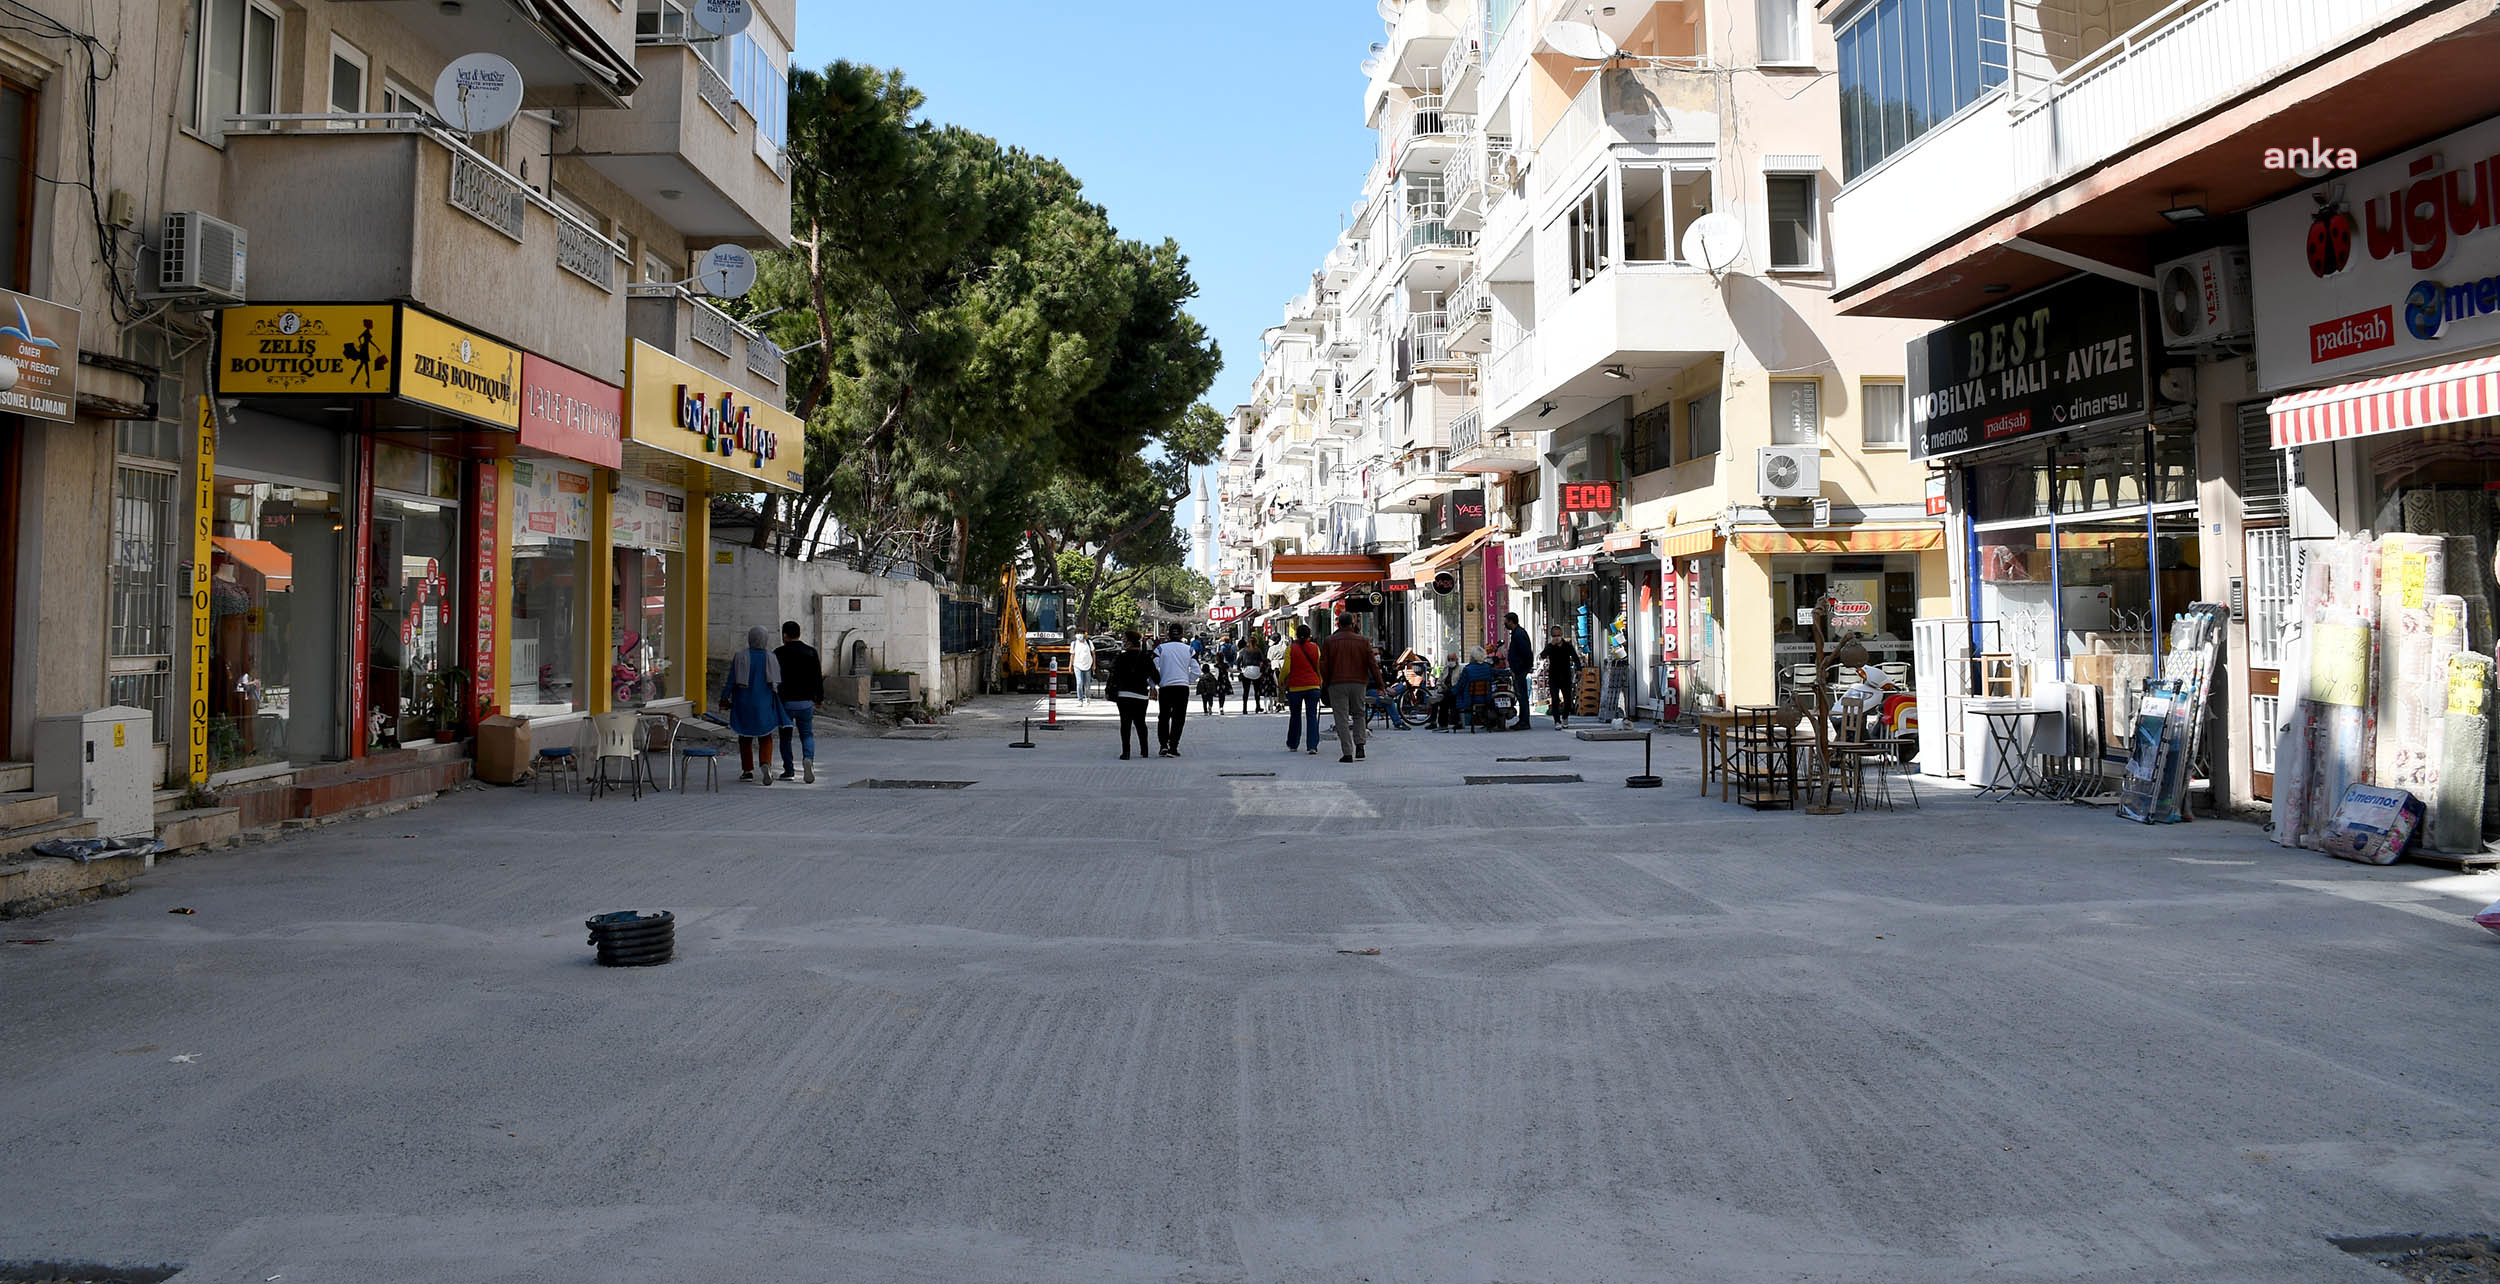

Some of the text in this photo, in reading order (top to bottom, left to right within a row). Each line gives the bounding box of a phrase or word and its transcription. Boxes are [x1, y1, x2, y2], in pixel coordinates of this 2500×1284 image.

[2365, 153, 2500, 270] uğu
[2202, 263, 2217, 326] VESTEL
[2445, 274, 2500, 323] me
[259, 336, 316, 358] ZELİŞ
[1967, 306, 2050, 379] BEST
[2316, 314, 2387, 359] padişah
[18, 342, 41, 359] ÖMER
[30, 361, 60, 377] RESORT
[230, 358, 344, 377] BOUTIQUE
[414, 353, 511, 404] ZELİŞ BOUTIQUE
[2001, 360, 2047, 400] HALI
[30, 395, 67, 416] LOJMANI
[2069, 392, 2128, 420] dinarsu
[1986, 412, 2027, 436] padişah
[1930, 425, 1968, 449] merinos
[1565, 485, 1612, 509] ECO
[1455, 503, 1484, 516] YADE
[2293, 547, 2307, 596] YOLLUK
[2354, 792, 2399, 808] merinos
